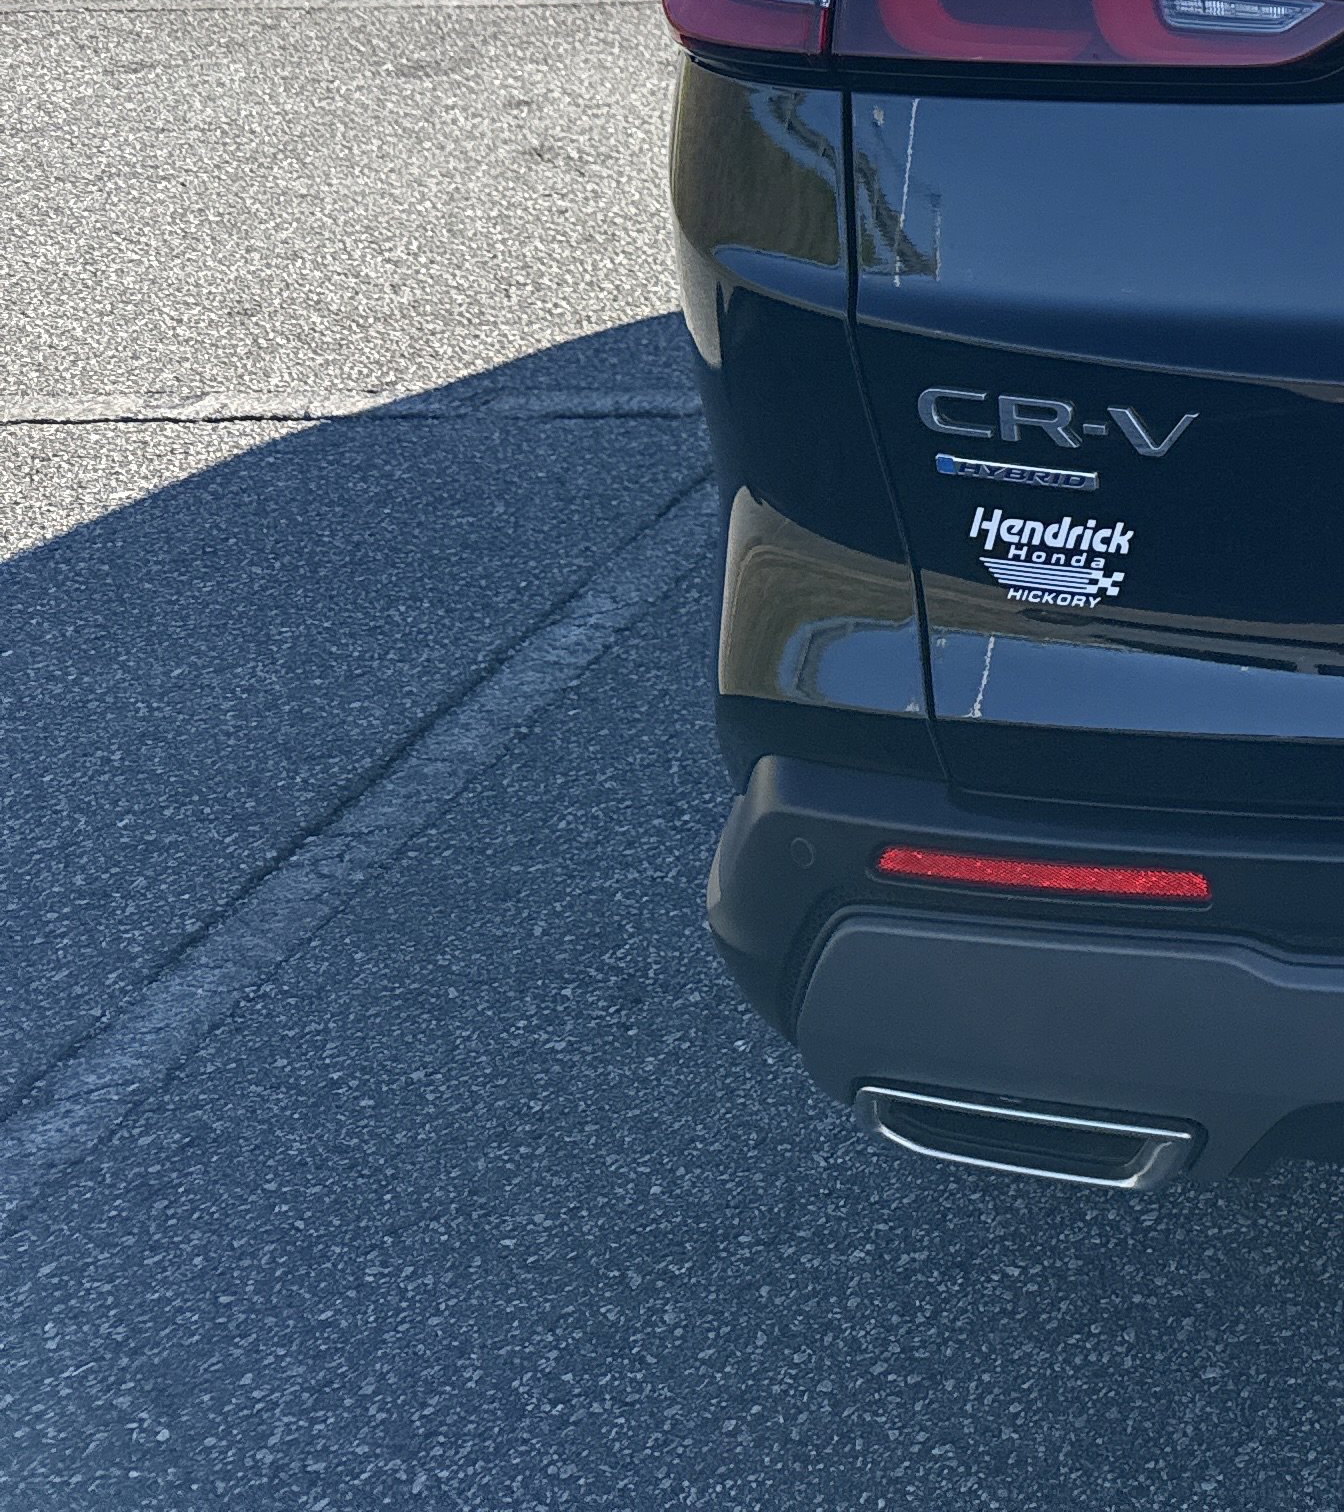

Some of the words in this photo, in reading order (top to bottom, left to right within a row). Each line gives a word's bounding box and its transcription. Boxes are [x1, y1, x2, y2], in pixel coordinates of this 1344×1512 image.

[917, 388, 1200, 457] CR-V
[958, 461, 1088, 488] HYBRID
[969, 506, 1135, 555] Hendrick
[1008, 545, 1106, 569] Honda
[1006, 588, 1102, 608] HICKORY
